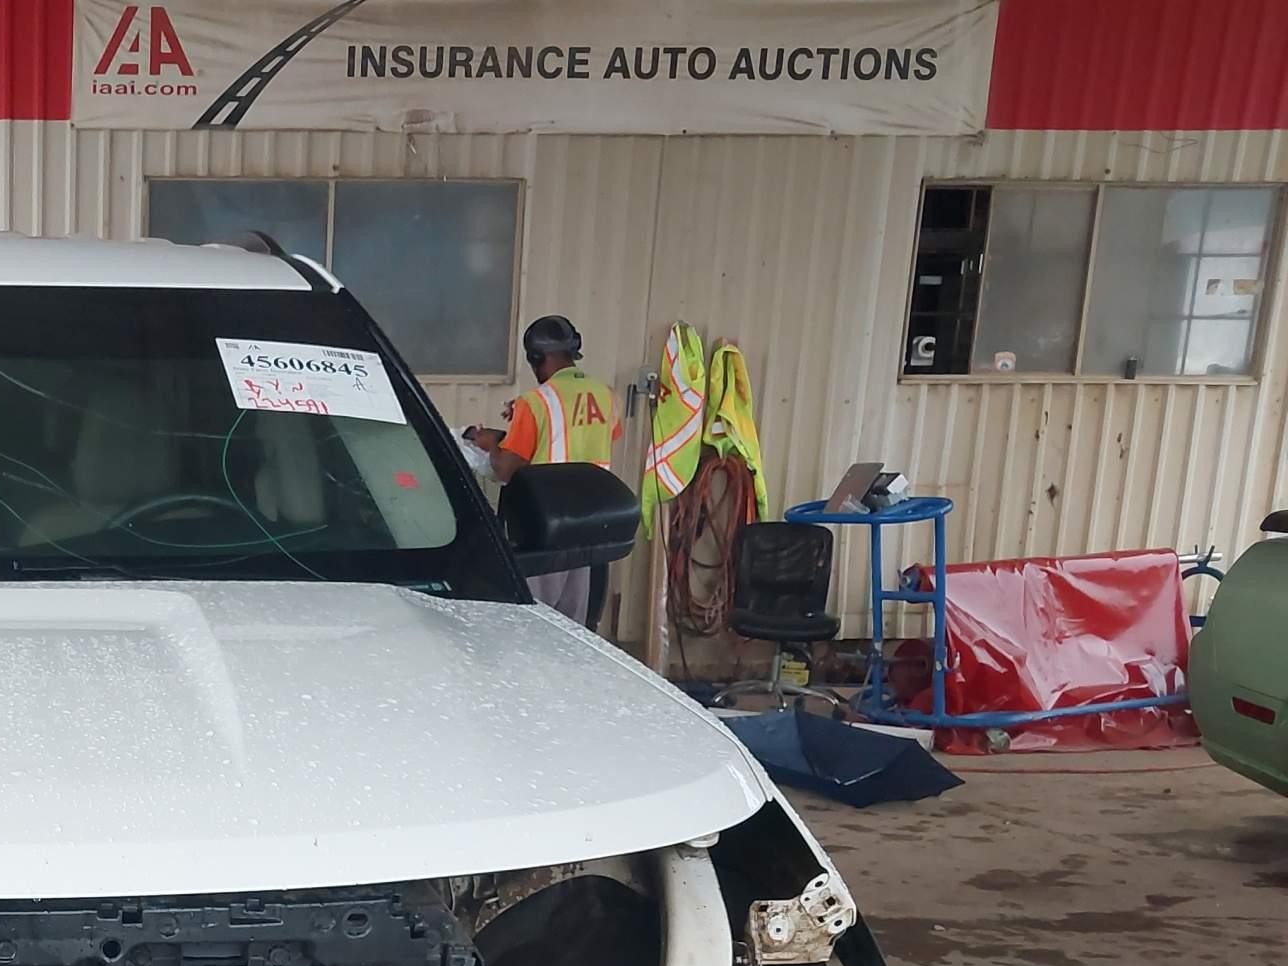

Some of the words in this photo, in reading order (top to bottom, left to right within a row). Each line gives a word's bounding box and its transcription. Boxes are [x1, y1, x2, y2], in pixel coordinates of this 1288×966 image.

[346, 45, 591, 80] INSURANCE
[603, 46, 717, 81] AUTO
[728, 47, 938, 81] AUCTIONS
[92, 79, 197, 96] iaai.com
[240, 354, 369, 378] 45606845
